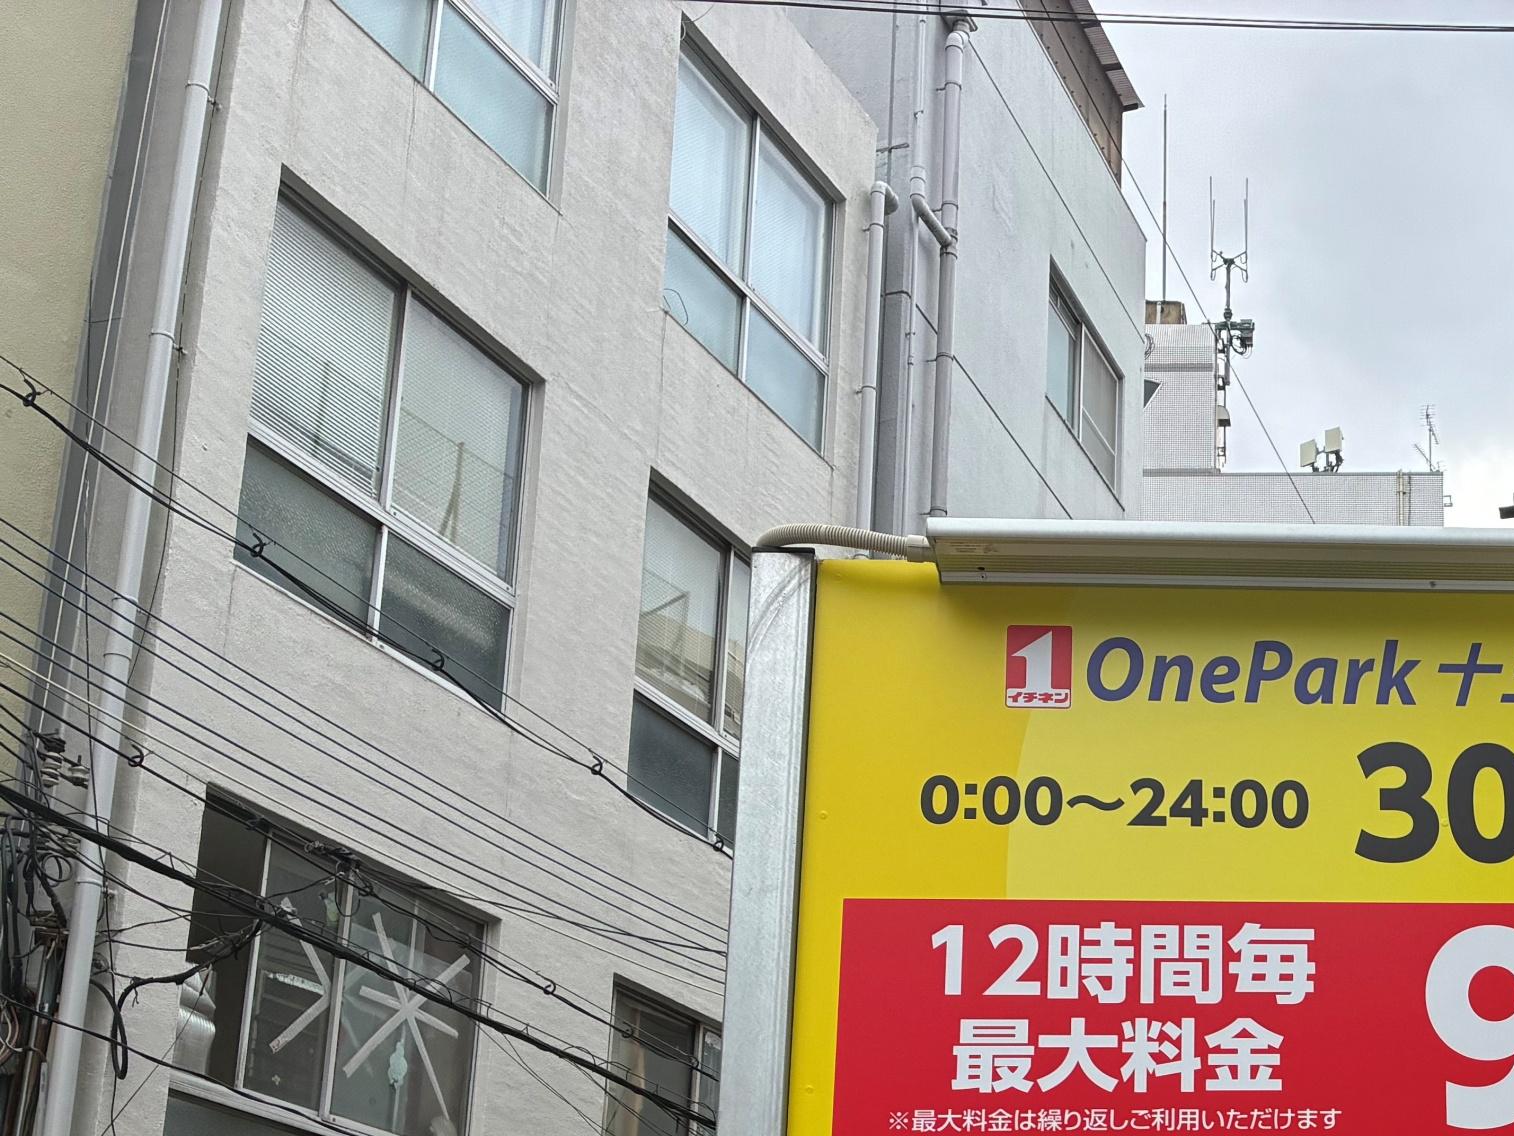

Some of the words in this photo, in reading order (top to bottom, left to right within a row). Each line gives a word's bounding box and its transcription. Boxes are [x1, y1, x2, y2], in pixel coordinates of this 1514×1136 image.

[1008, 691, 1069, 703] イチネン
[1086, 637, 1420, 705] OnePark
[930, 921, 1317, 1004] 12時間毎
[950, 1018, 1285, 1094] 最大料金
